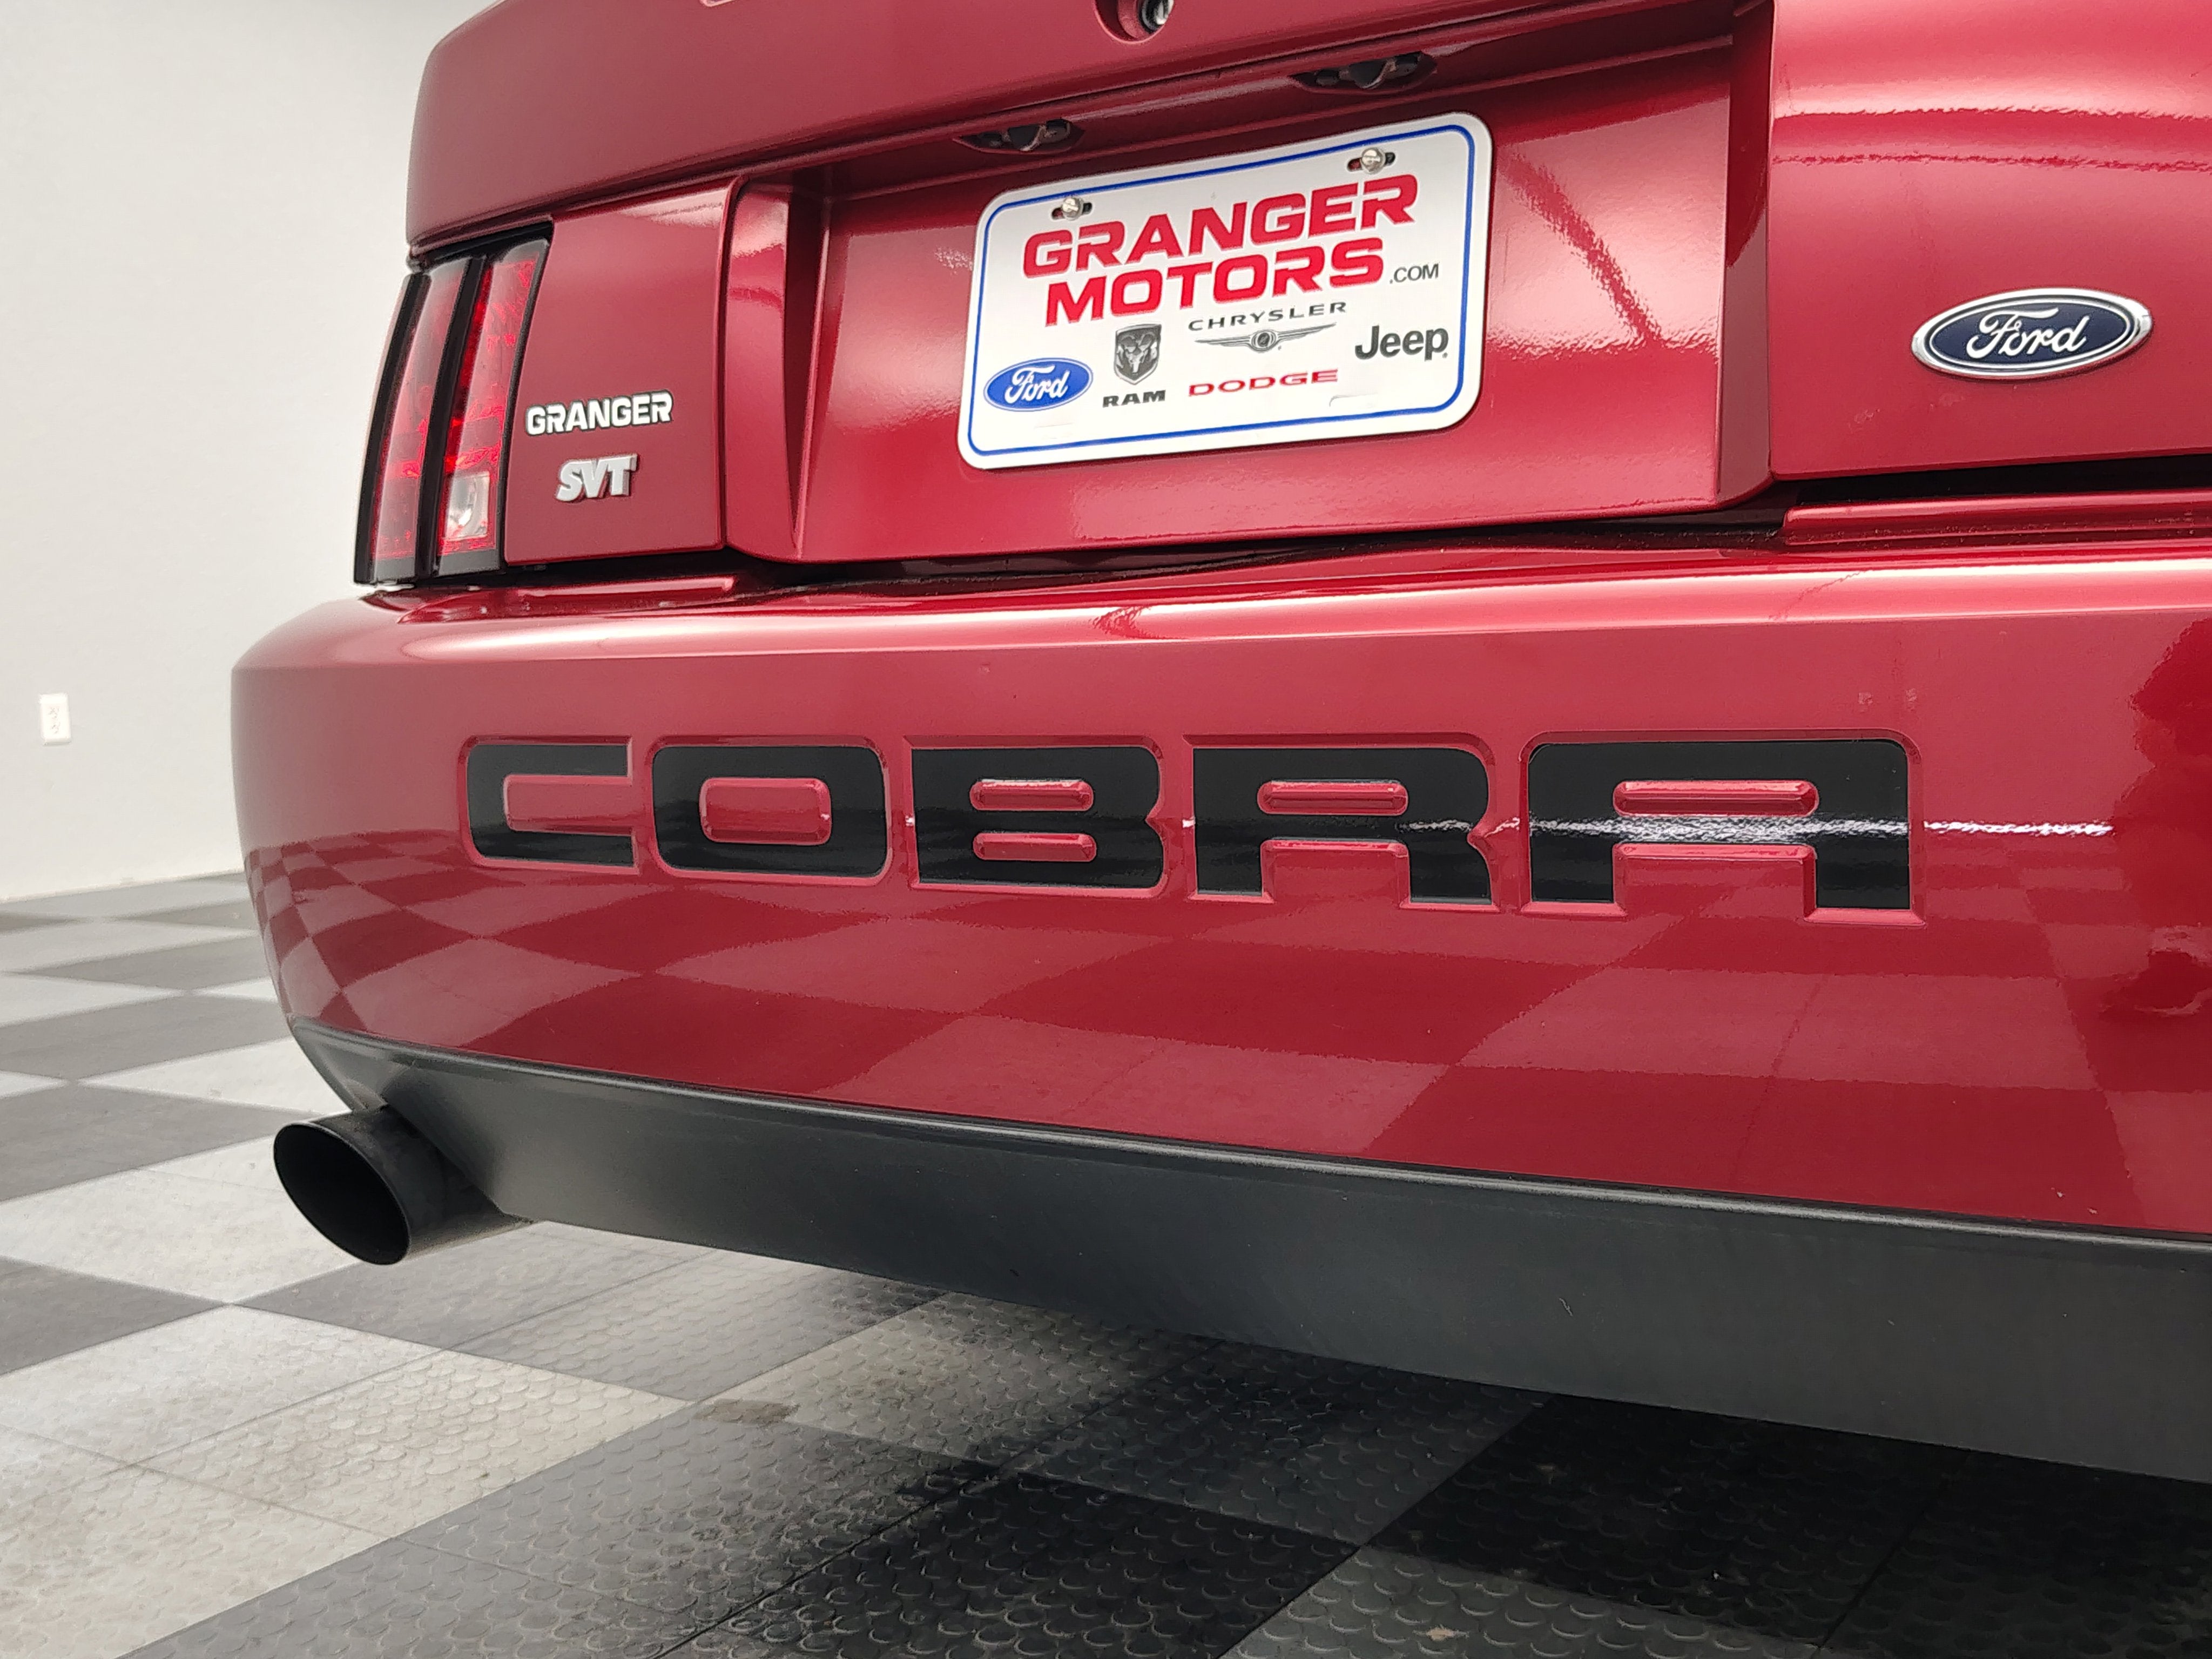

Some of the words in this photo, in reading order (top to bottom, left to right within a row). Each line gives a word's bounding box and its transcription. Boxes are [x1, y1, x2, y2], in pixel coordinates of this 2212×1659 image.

[1023, 173, 1419, 279] GRANGER
[1044, 237, 1385, 327] MOTORS
[1188, 301, 1347, 332] CHRYSLER
[1966, 307, 2090, 359] Ford
[1354, 325, 1449, 362] Jeep
[1004, 366, 1071, 404] Ford
[1103, 389, 1166, 408] RAM
[1188, 368, 1339, 397] DODGE
[526, 389, 674, 436] GRANGER
[555, 454, 638, 503] SVT
[466, 738, 1914, 918] COBRA
